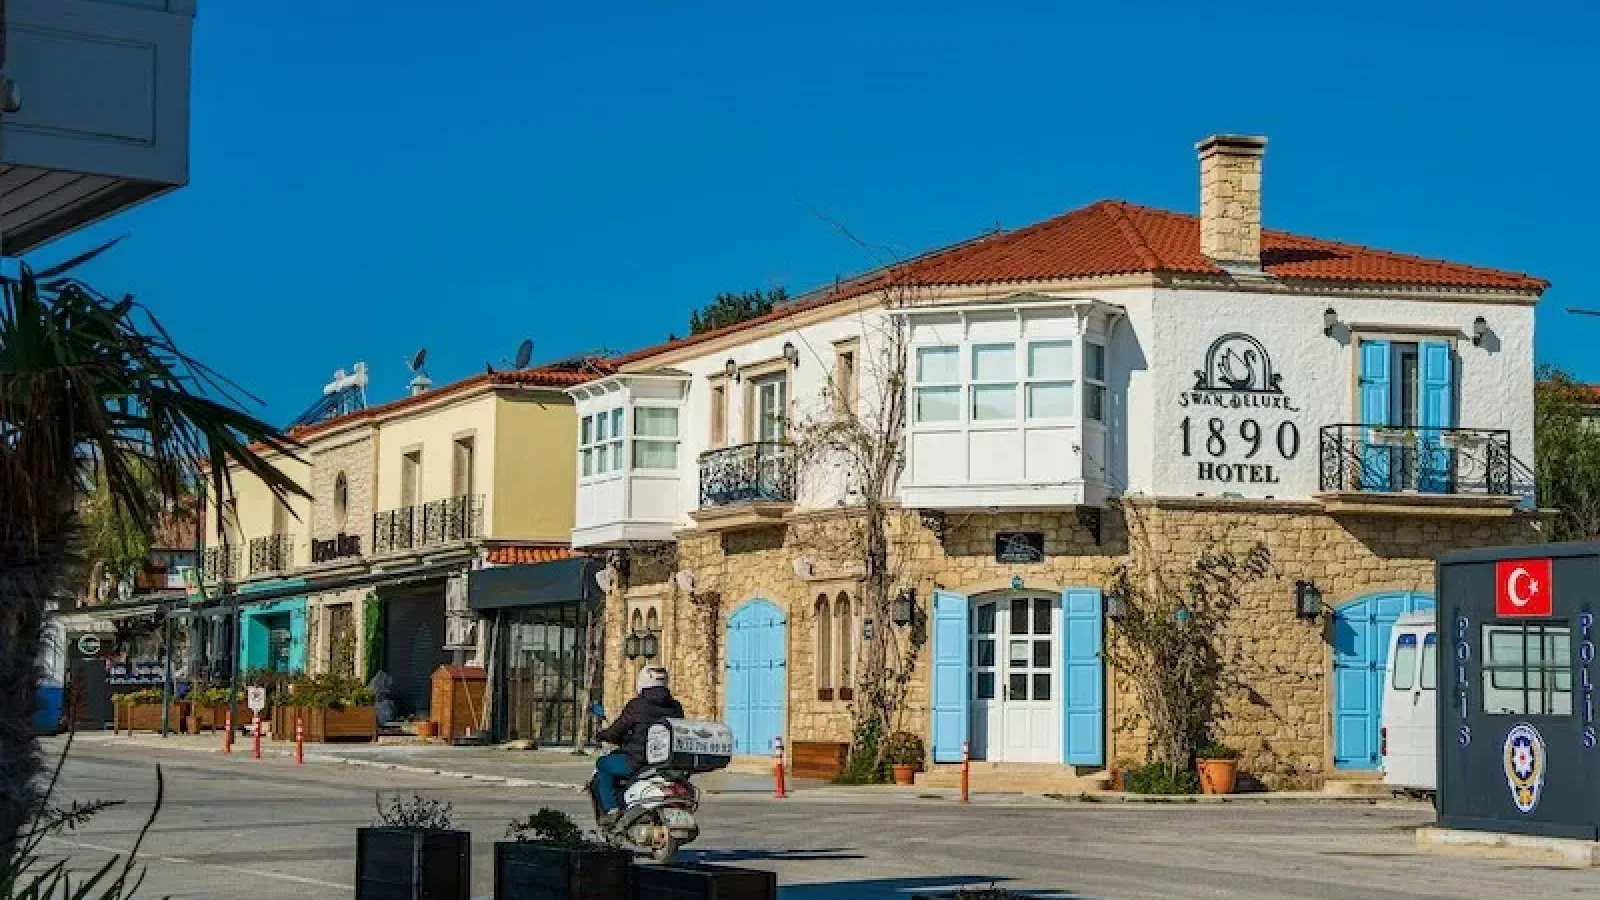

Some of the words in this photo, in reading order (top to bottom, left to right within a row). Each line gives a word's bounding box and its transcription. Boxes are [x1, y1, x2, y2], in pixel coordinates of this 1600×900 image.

[1178, 392, 1228, 408] SWAN
[1180, 416, 1300, 460] 1890
[1197, 461, 1280, 483] HOTEL
